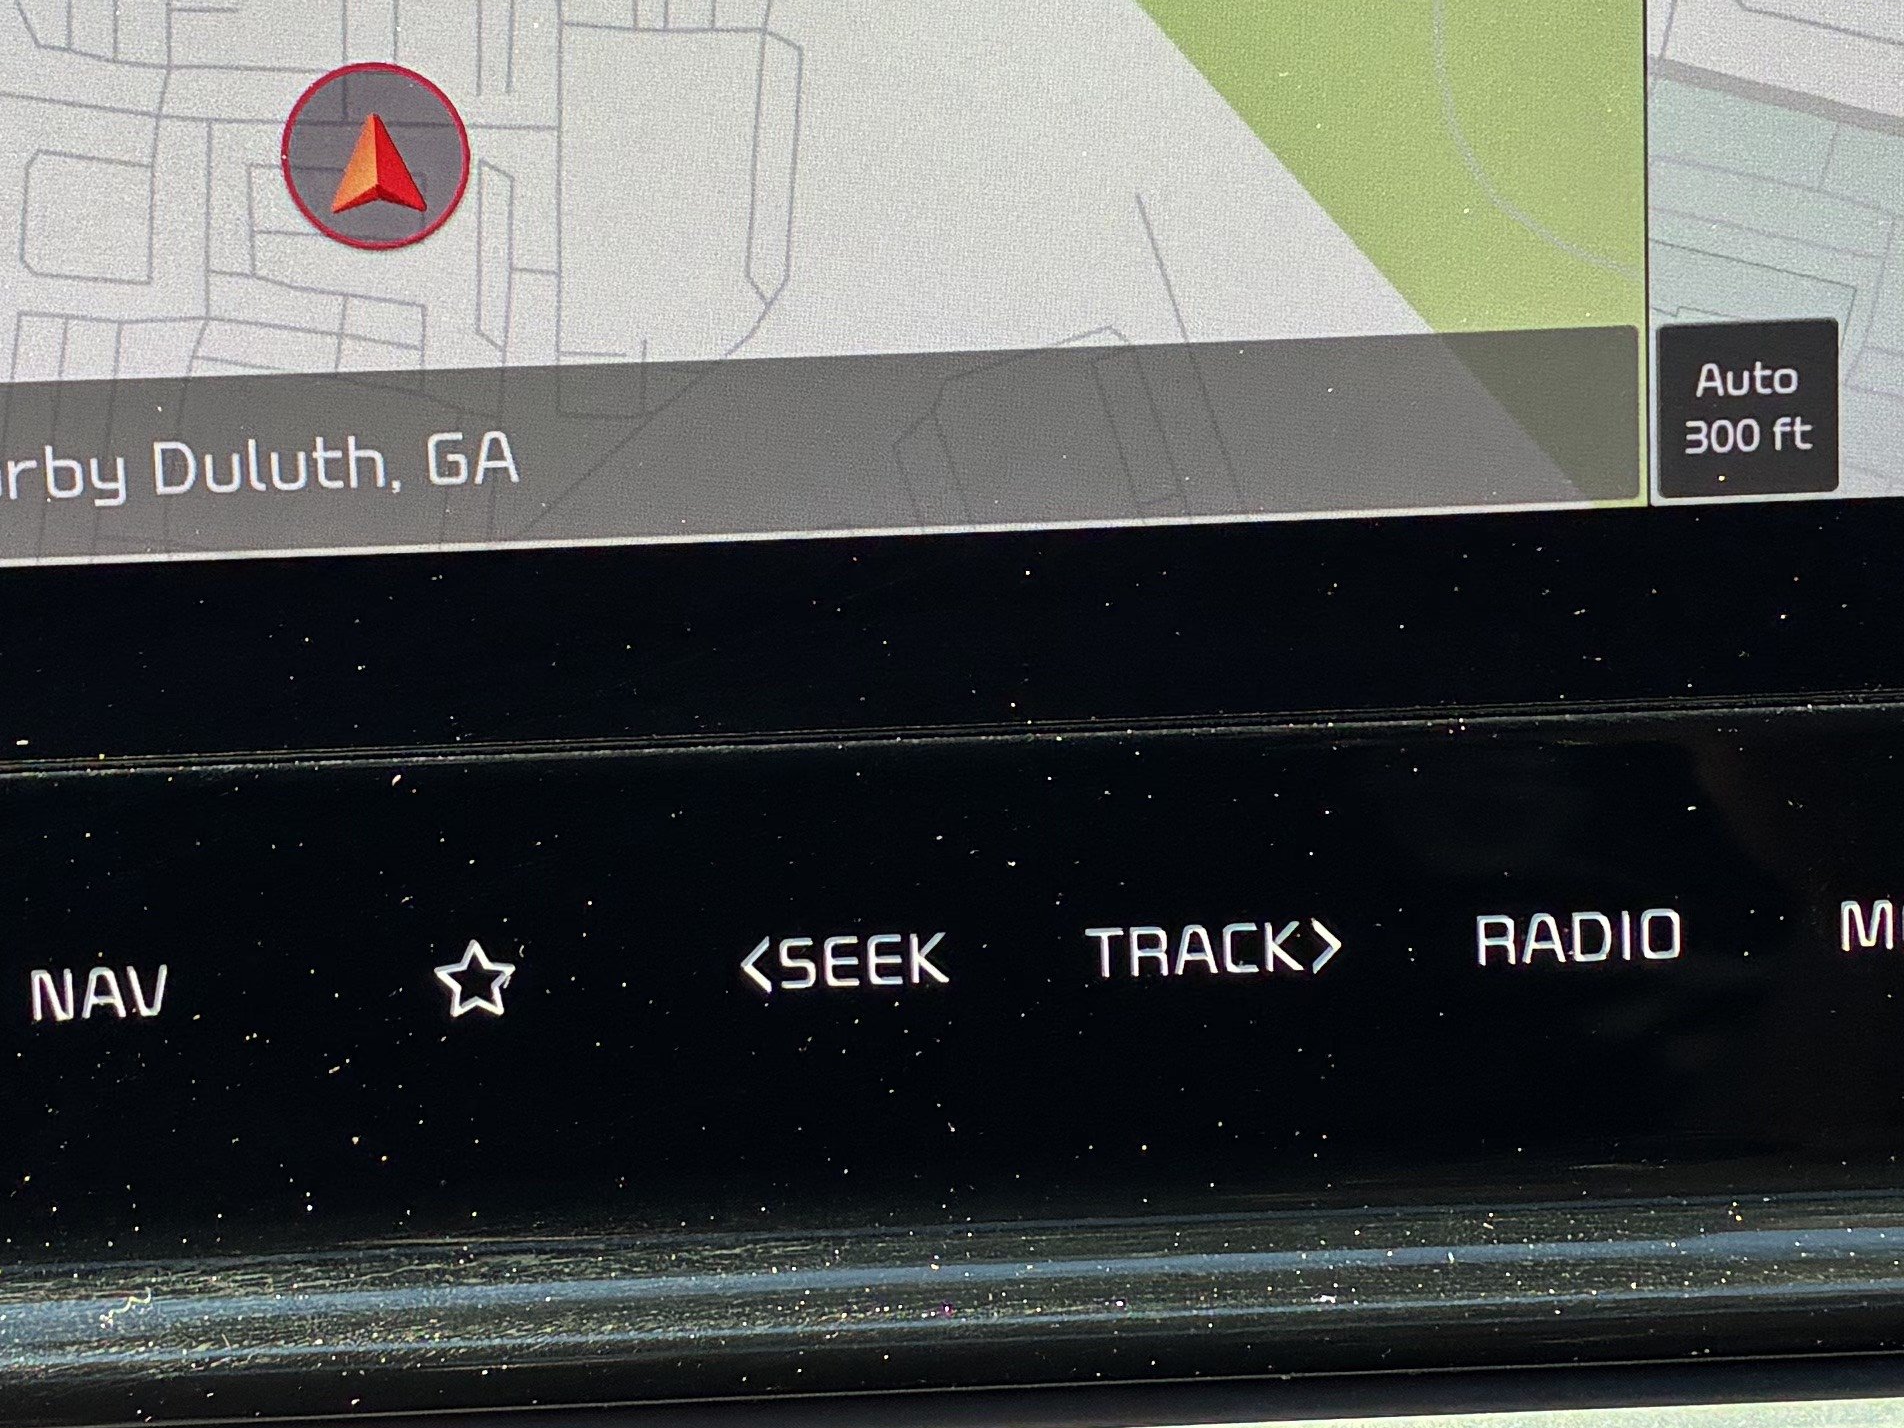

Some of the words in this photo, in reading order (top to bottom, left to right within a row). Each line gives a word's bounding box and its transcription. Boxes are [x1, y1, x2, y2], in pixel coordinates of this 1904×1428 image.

[1694, 360, 1799, 399] Auto
[152, 434, 403, 497] Duluth,
[426, 429, 521, 487] GA
[1683, 417, 1762, 456] 300
[1771, 415, 1814, 452] ft
[1475, 907, 1682, 968] RADIO
[29, 963, 169, 1023] NAV
